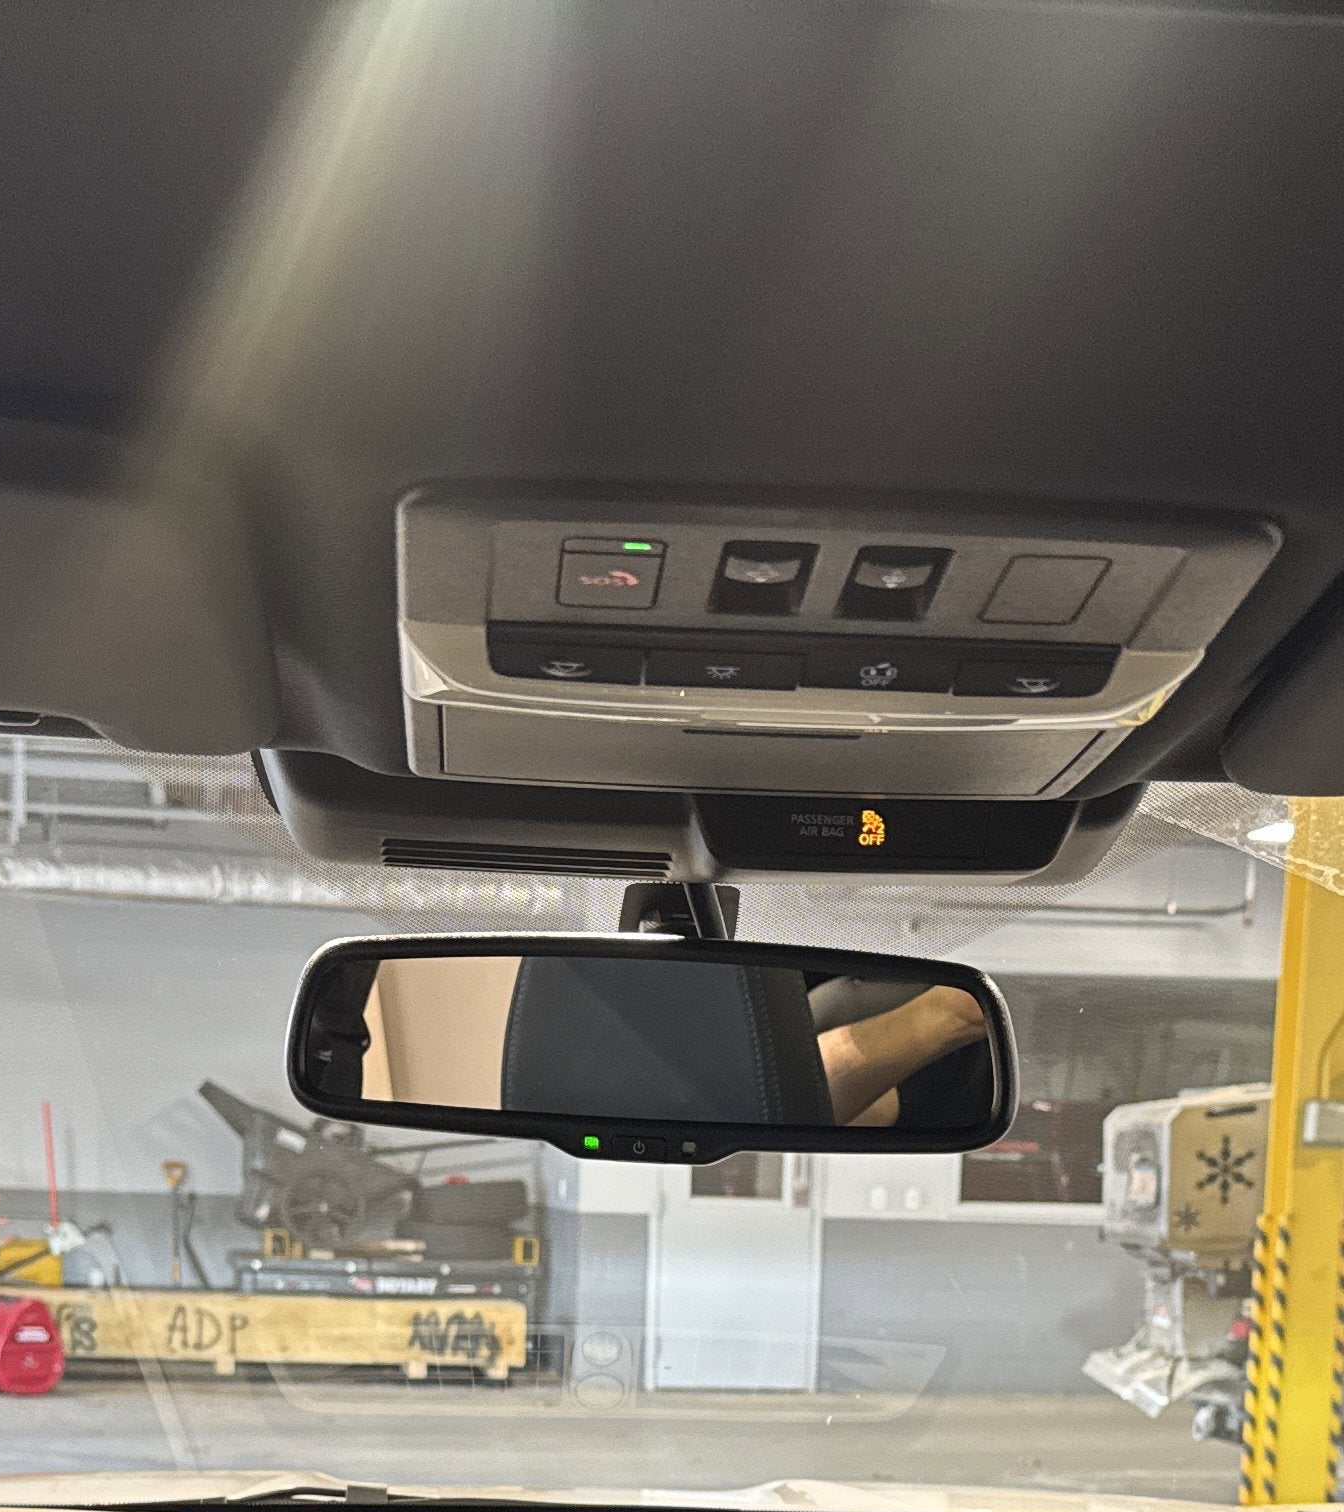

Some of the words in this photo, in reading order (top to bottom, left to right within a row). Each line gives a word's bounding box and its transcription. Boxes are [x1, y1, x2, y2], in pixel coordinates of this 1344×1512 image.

[579, 576, 626, 587] SOS
[791, 814, 854, 825] PASSENGER
[800, 826, 817, 836] AIR
[822, 826, 845, 837] BAG
[858, 834, 885, 846] OFF
[167, 1304, 249, 1353] ADP
